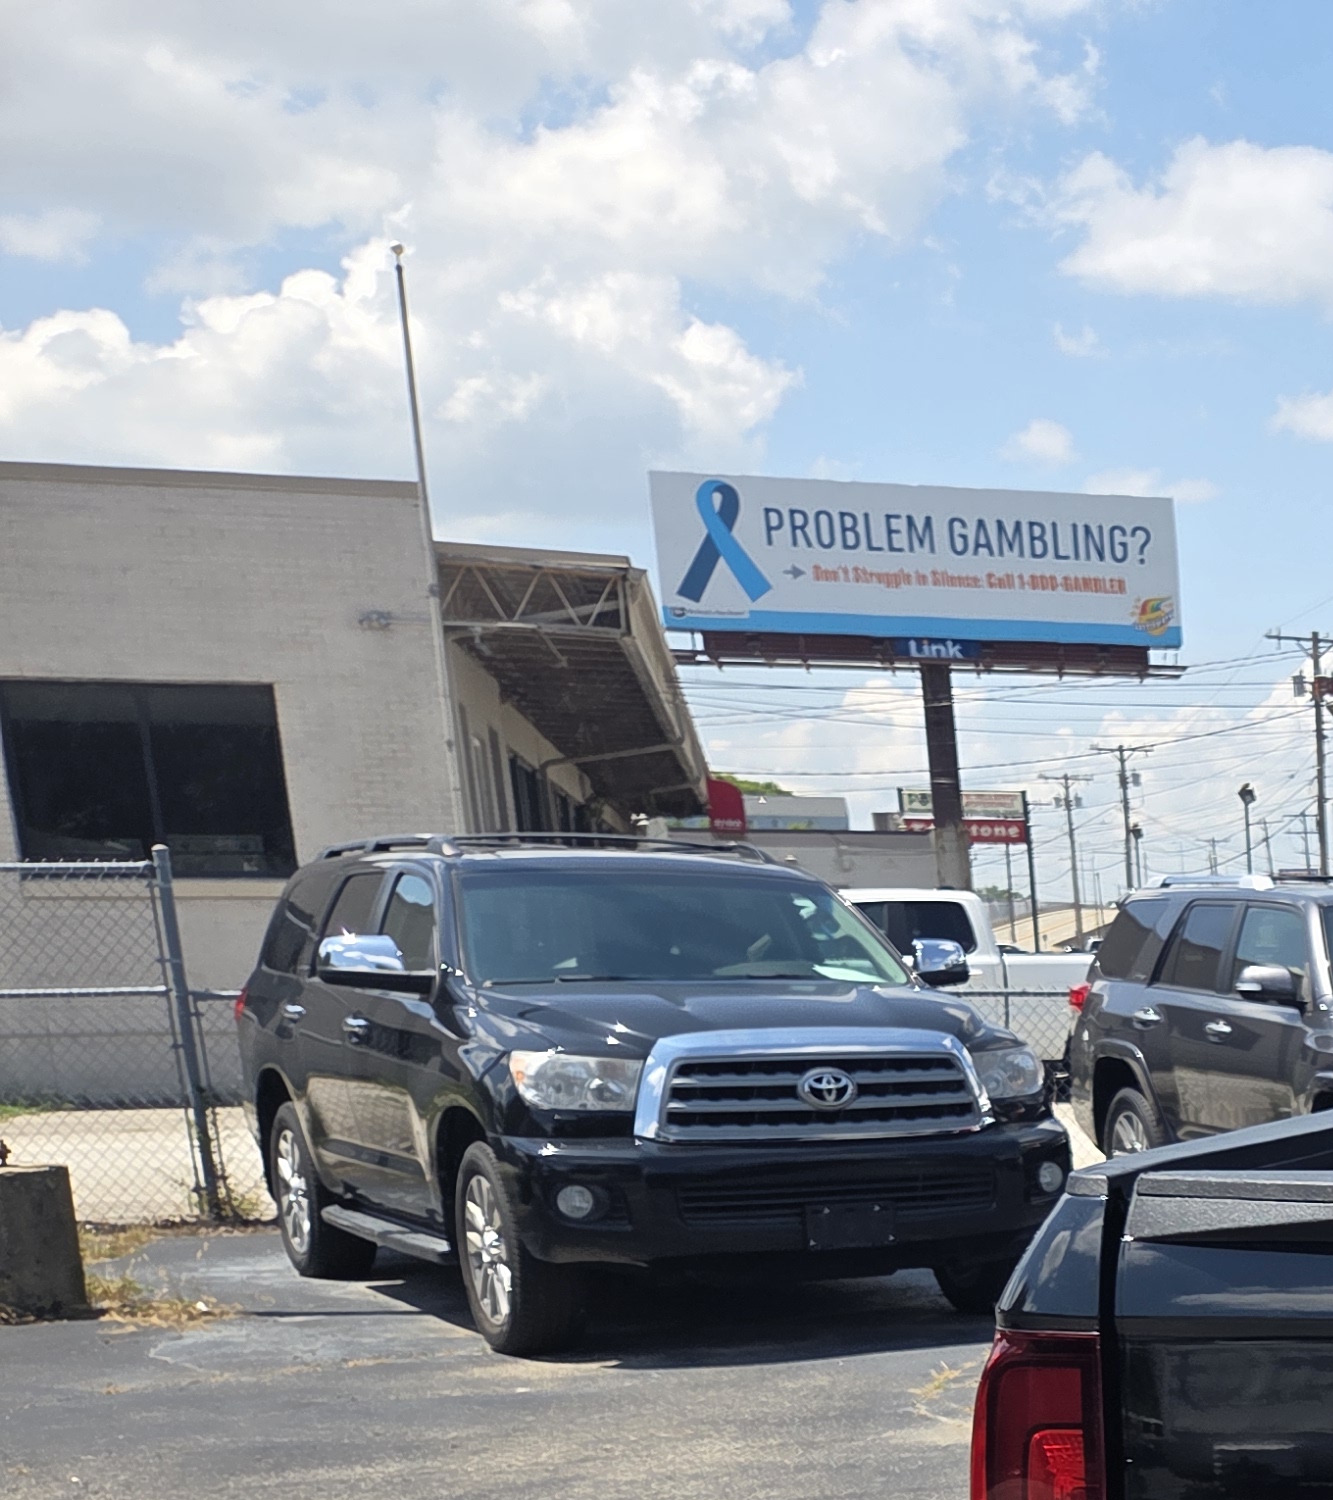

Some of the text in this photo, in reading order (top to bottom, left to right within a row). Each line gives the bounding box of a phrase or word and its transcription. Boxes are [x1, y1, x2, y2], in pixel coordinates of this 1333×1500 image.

[763, 506, 1152, 565] PROBLEM GAMBLING?
[908, 639, 964, 659] Link
